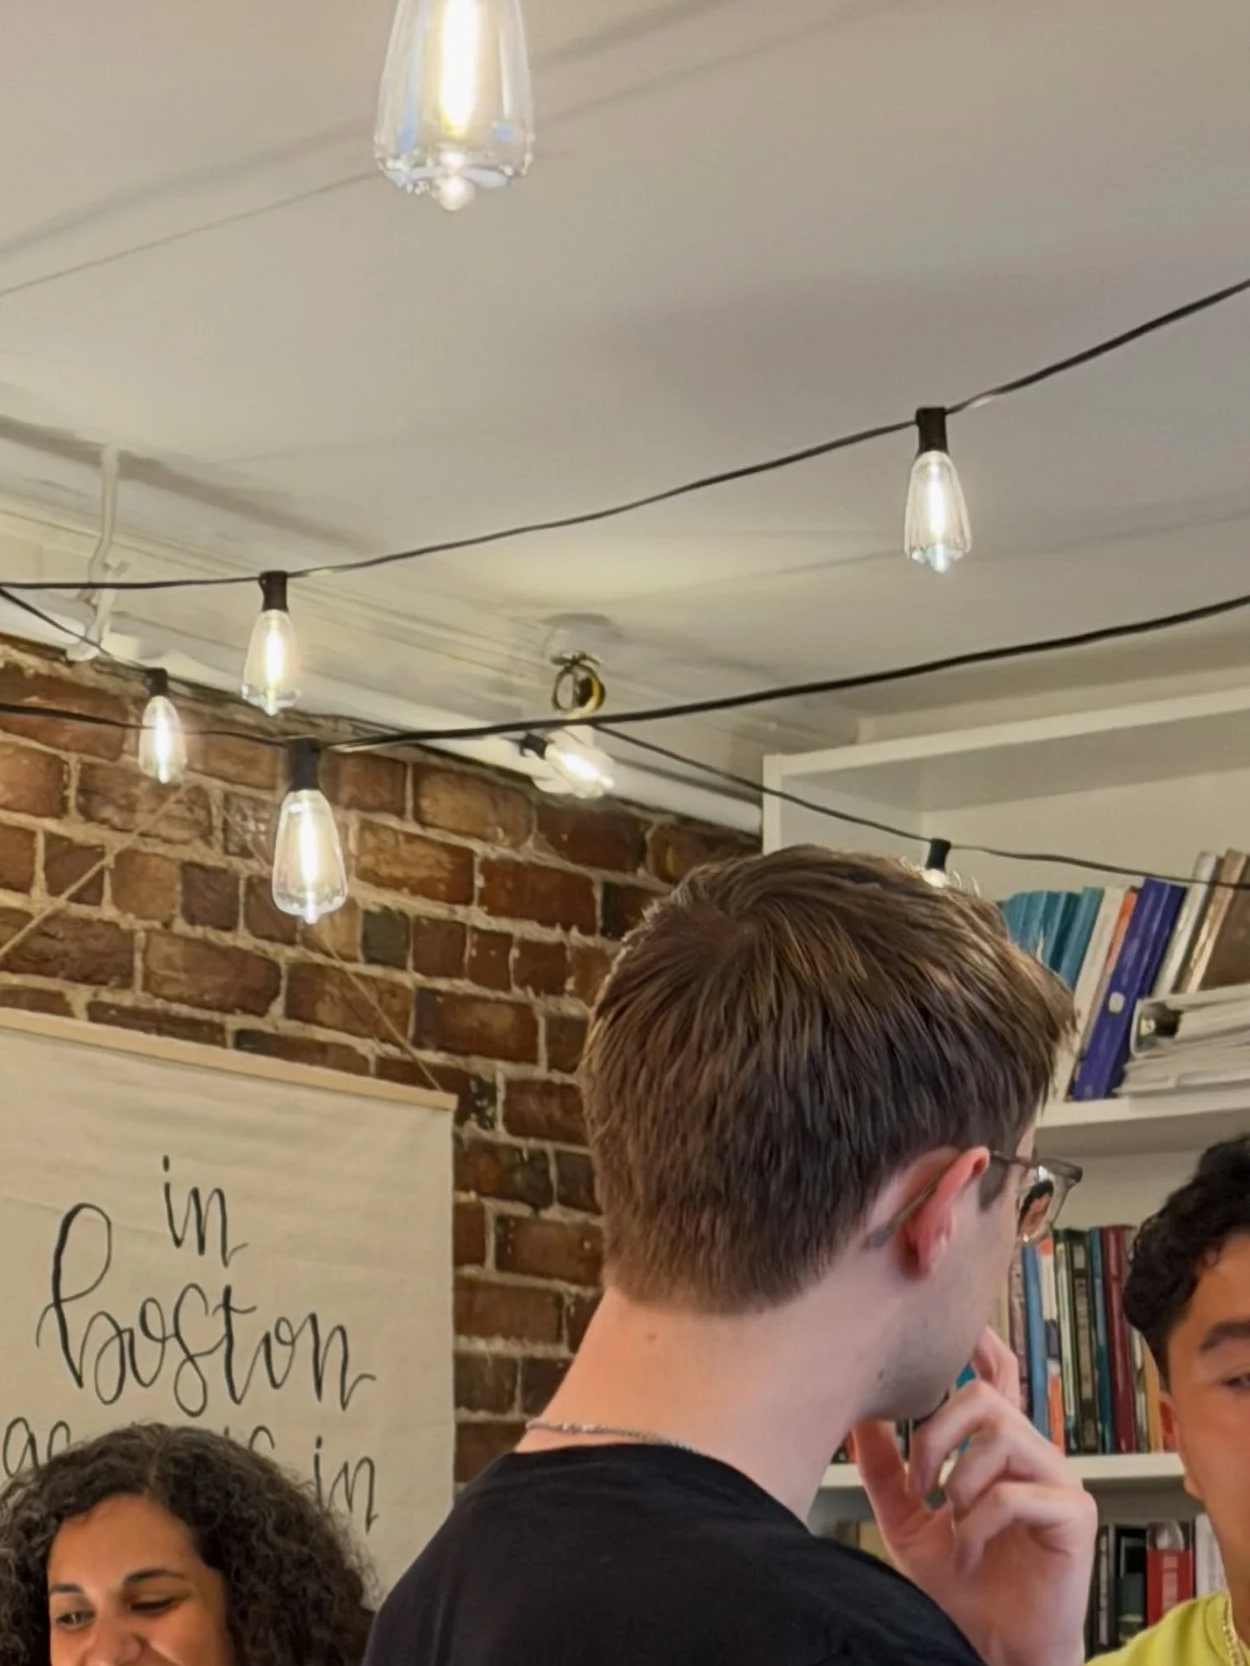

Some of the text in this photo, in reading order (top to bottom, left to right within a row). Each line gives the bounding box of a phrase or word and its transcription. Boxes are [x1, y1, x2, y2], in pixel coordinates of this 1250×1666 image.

[162, 1154, 248, 1268] in
[36, 1203, 376, 1418] boston
[312, 1436, 378, 1534] in
